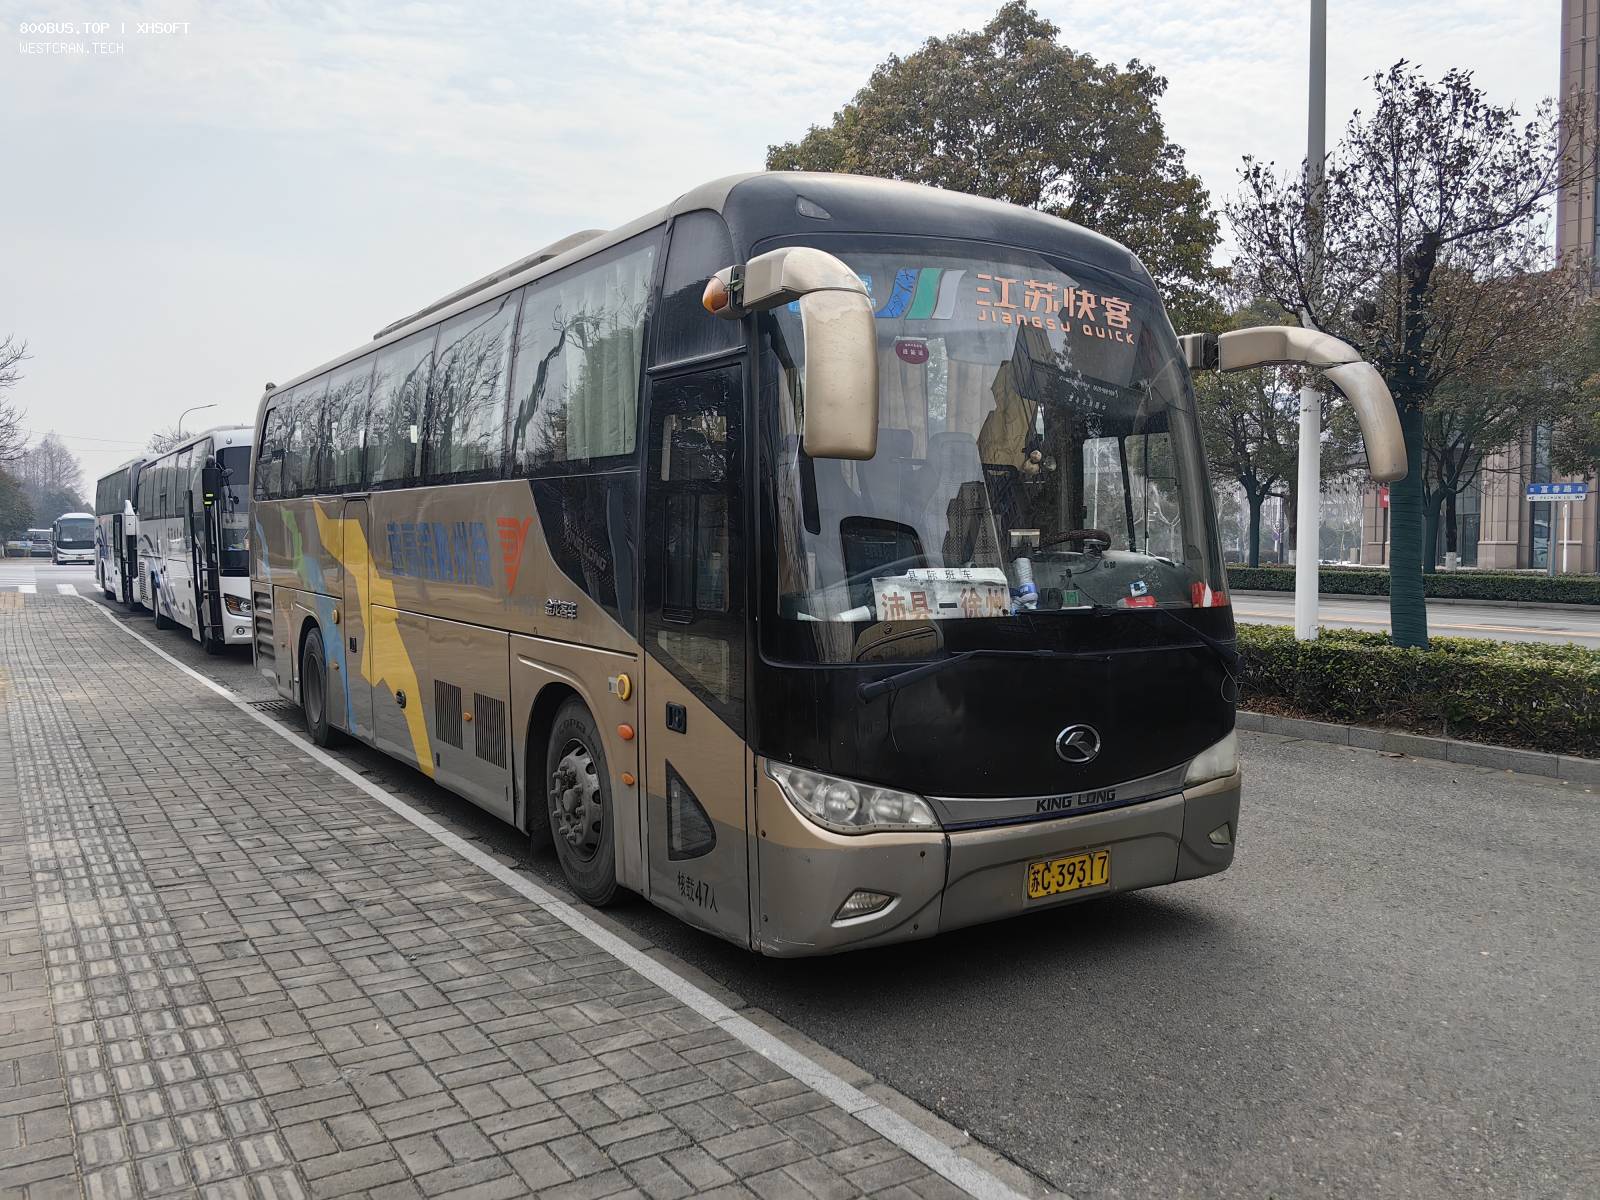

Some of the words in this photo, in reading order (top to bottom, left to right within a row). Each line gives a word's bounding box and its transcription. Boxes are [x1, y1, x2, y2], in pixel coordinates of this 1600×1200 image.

[976, 273, 1132, 330] 江苏快客
[1083, 325, 1135, 345] QUICK
[1035, 795, 1073, 812] KING
[1077, 789, 1116, 806] LONG
[677, 870, 719, 913] 核载47人
